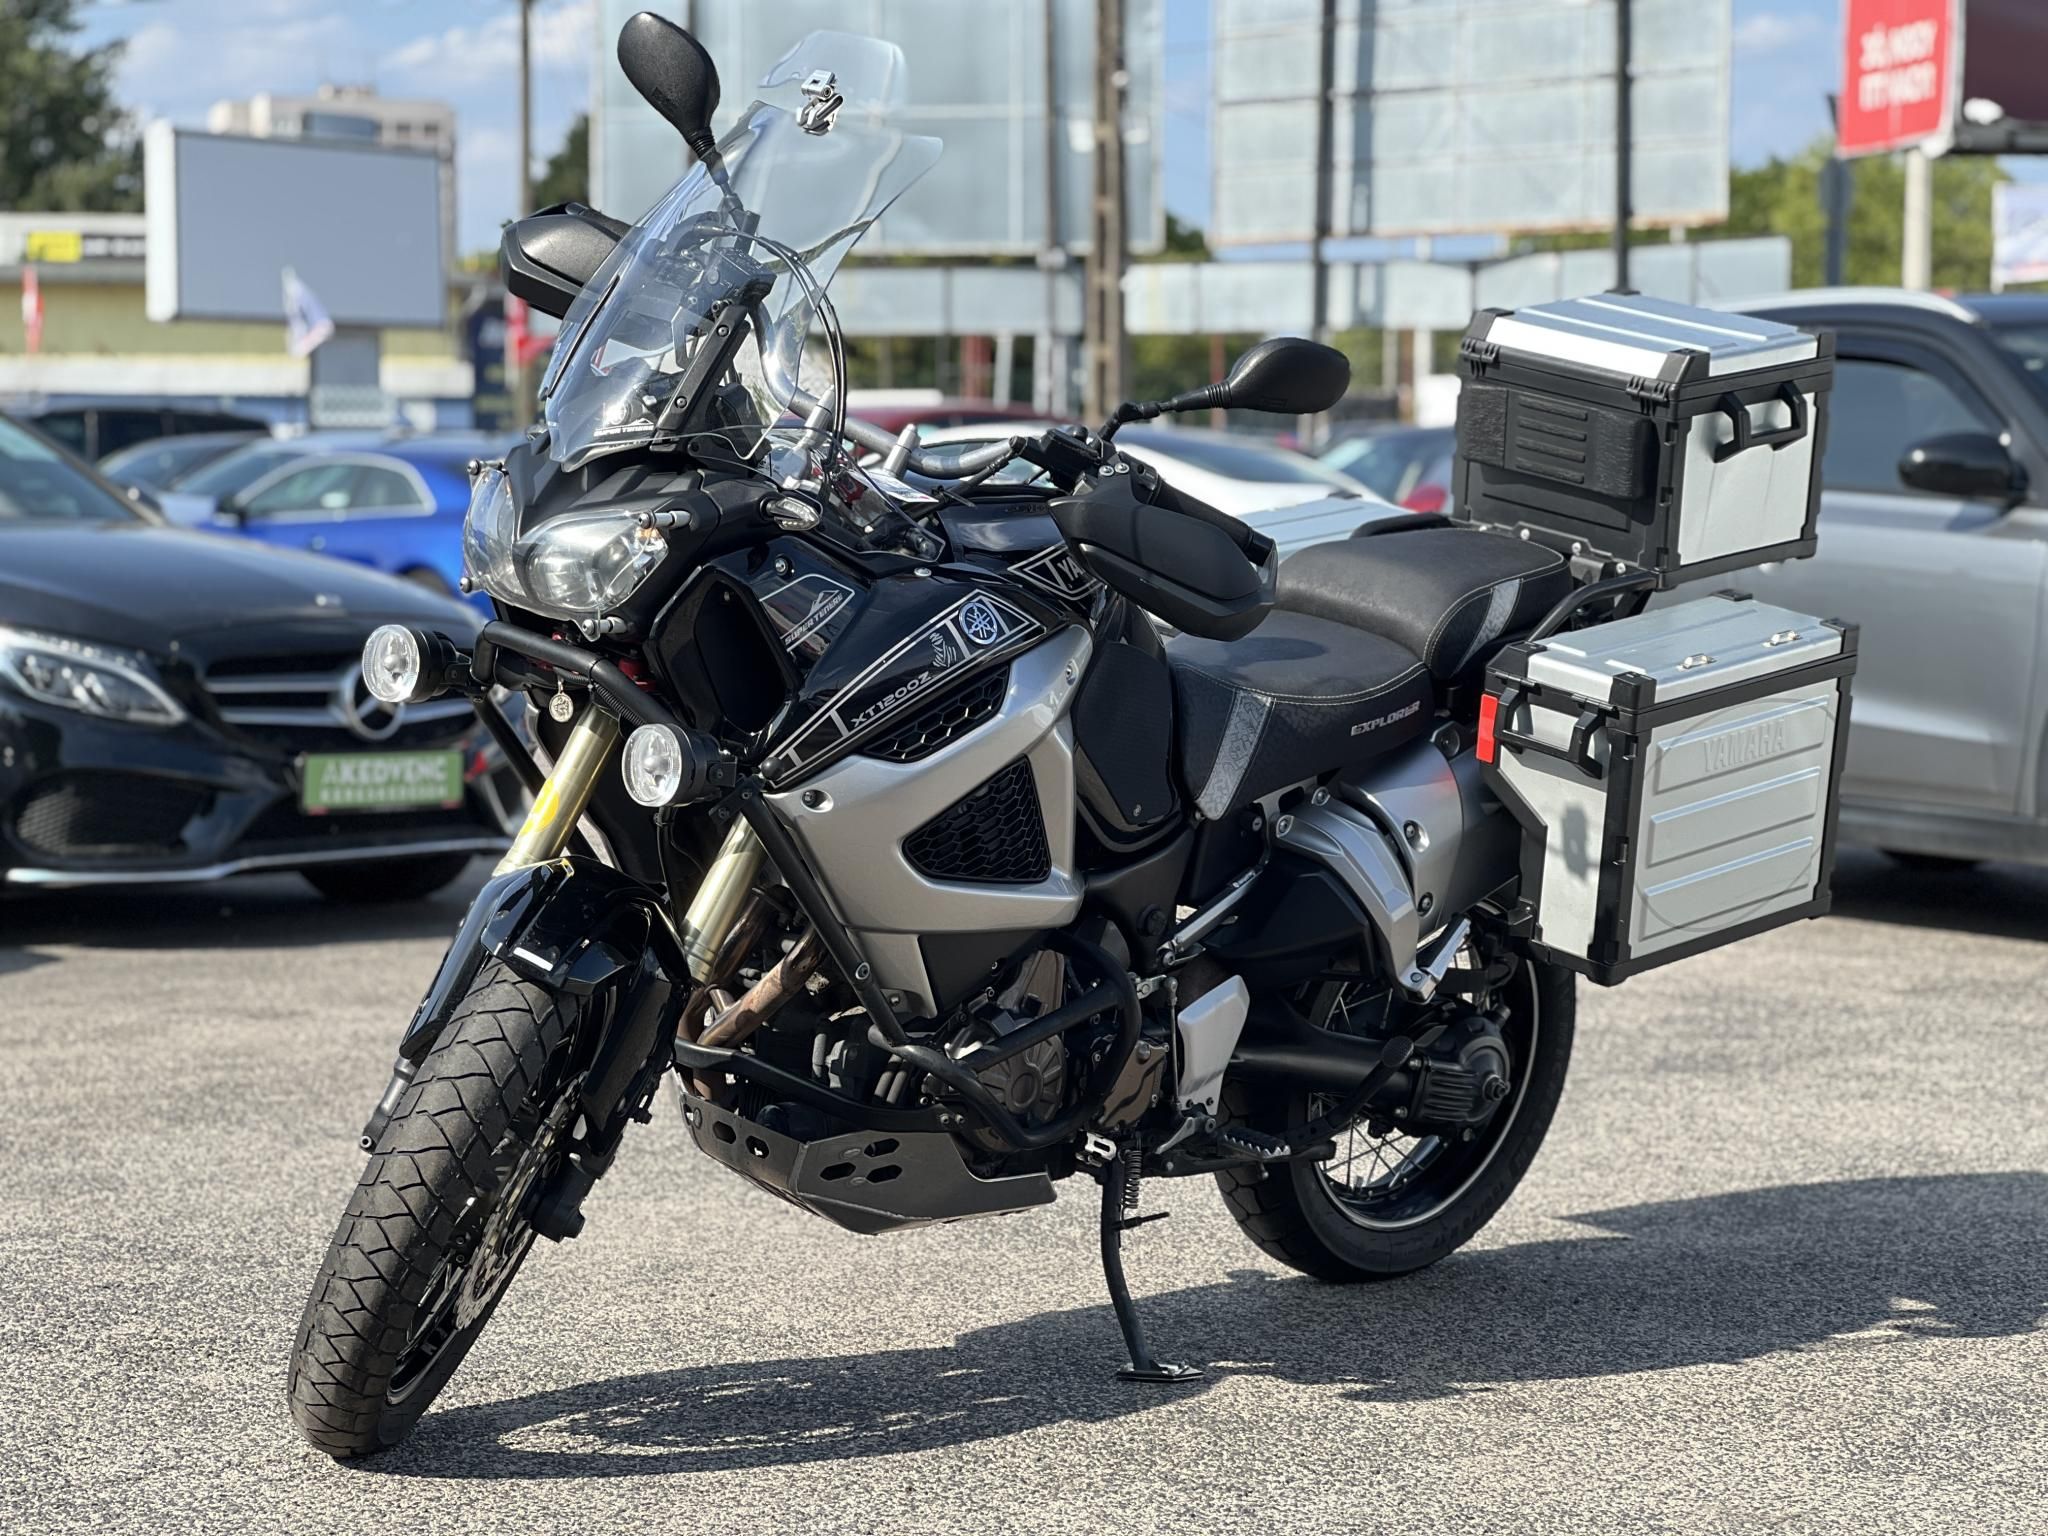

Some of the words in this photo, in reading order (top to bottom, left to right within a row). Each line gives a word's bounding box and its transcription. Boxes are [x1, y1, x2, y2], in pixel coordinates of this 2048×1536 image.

[1057, 556, 1086, 581] YA
[785, 620, 814, 645] SUPER
[851, 671, 931, 727] XT1200Z
[1350, 700, 1420, 736] EXPLORER
[1703, 718, 1786, 772] YAMAHA
